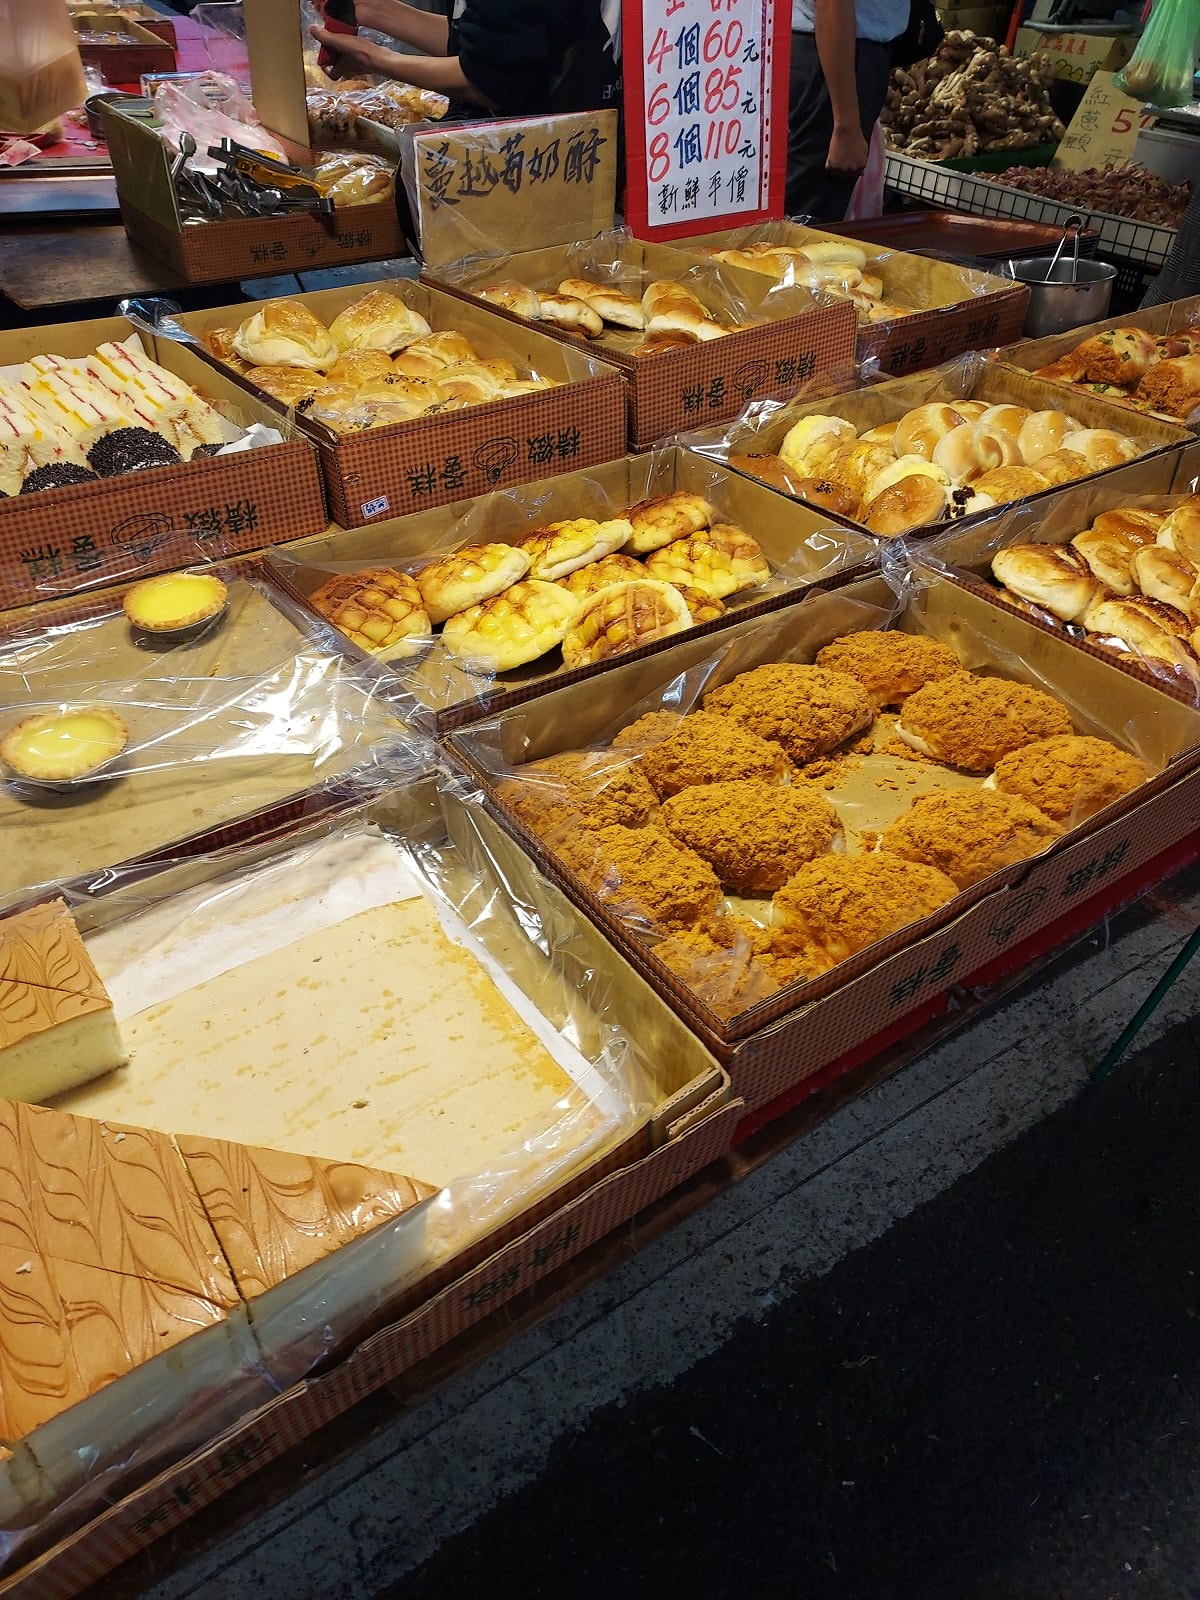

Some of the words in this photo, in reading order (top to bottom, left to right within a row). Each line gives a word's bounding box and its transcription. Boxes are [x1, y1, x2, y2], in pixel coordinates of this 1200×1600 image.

[647, 20, 759, 74] 4個60元
[647, 64, 757, 125] 6個85元
[649, 118, 757, 182] 8個110元
[657, 165, 748, 215] 新鮮平價
[682, 376, 728, 415] 蛋糕
[526, 426, 581, 464] 精緻
[407, 455, 468, 497] 蛋糕
